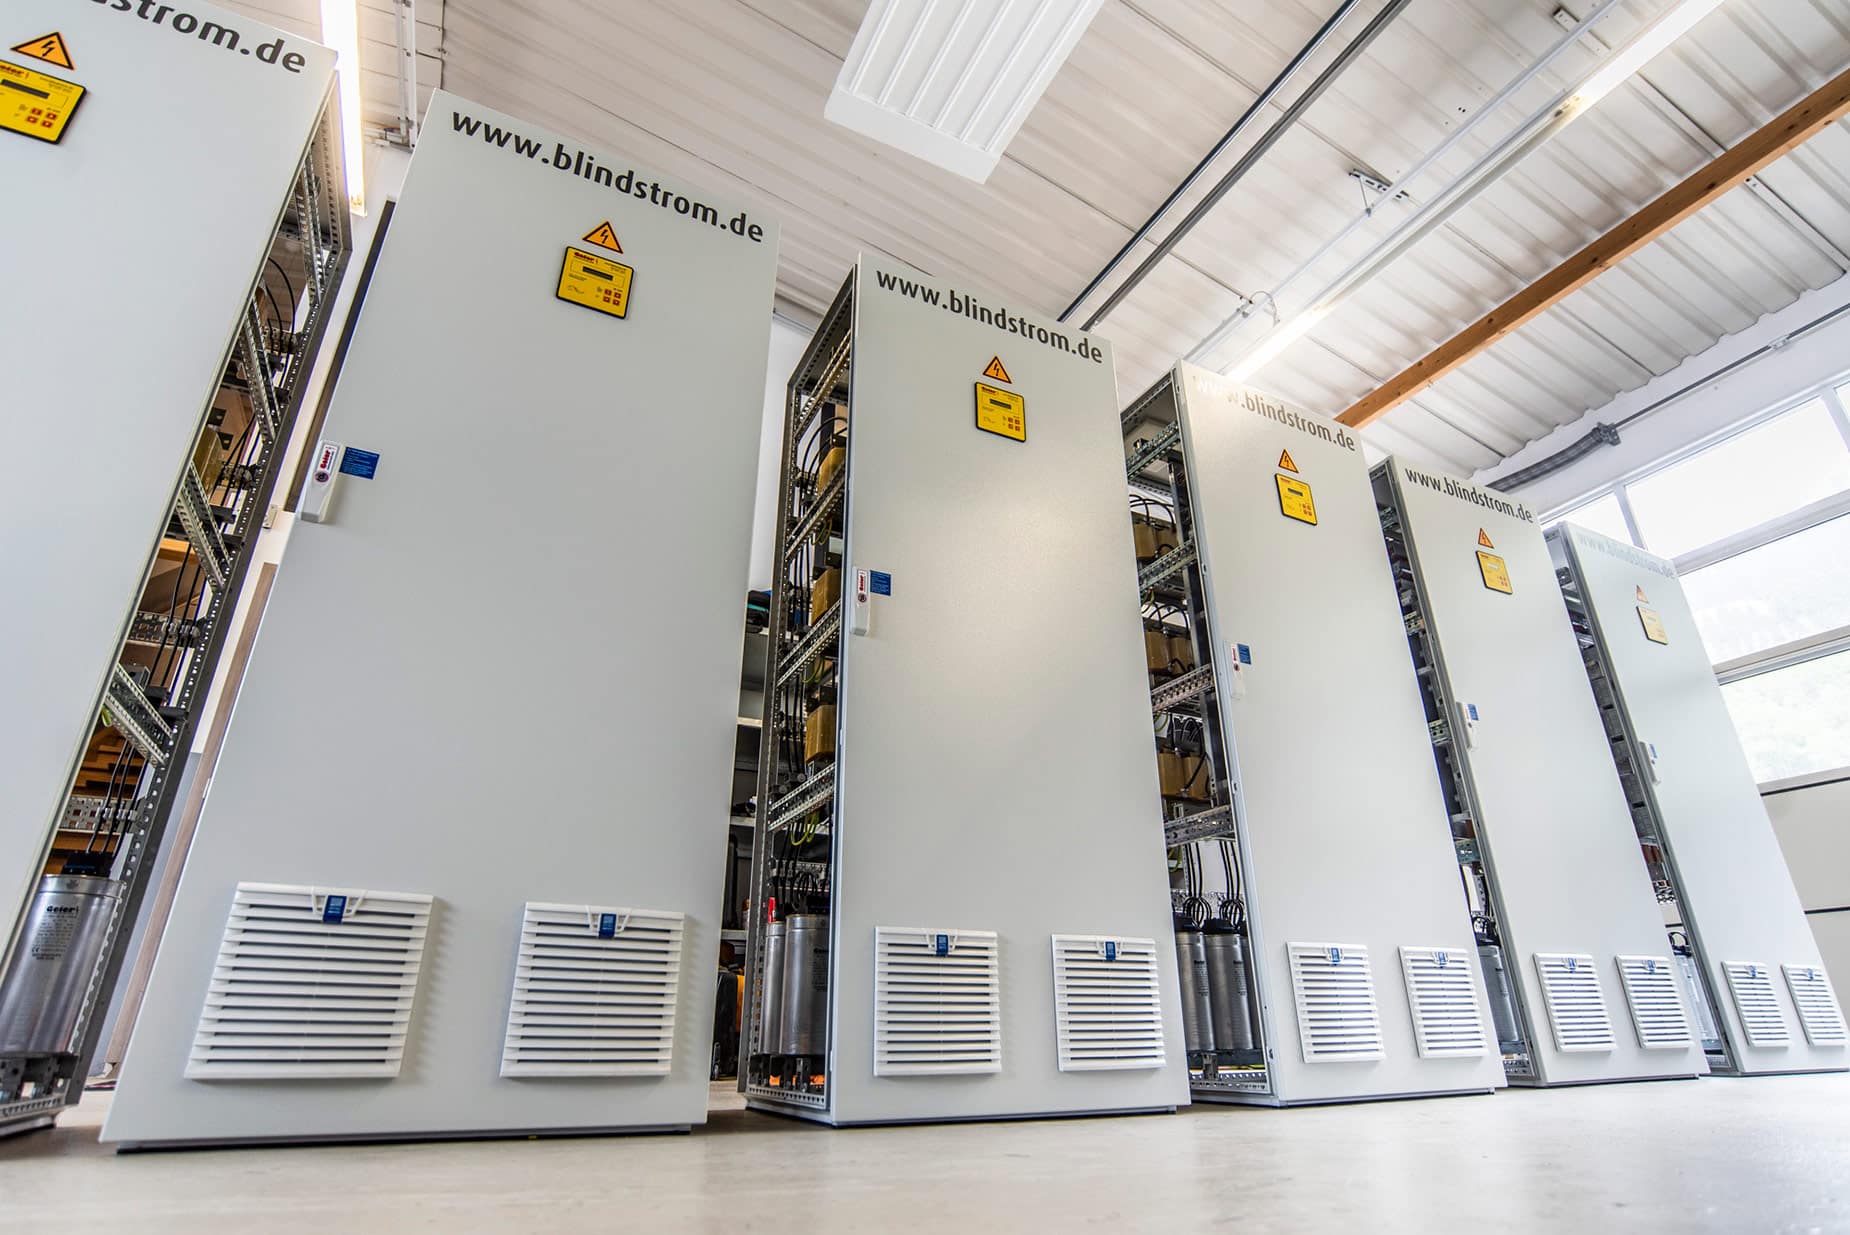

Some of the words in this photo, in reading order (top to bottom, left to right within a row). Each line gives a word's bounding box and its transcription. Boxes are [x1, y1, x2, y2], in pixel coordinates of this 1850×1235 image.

[452, 111, 764, 243] www.blindstrom.de
[876, 270, 1103, 364] www.blindstrom.de
[1192, 375, 1356, 451] w.blindstrom.de
[1405, 467, 1534, 523] www.blindstrom.de
